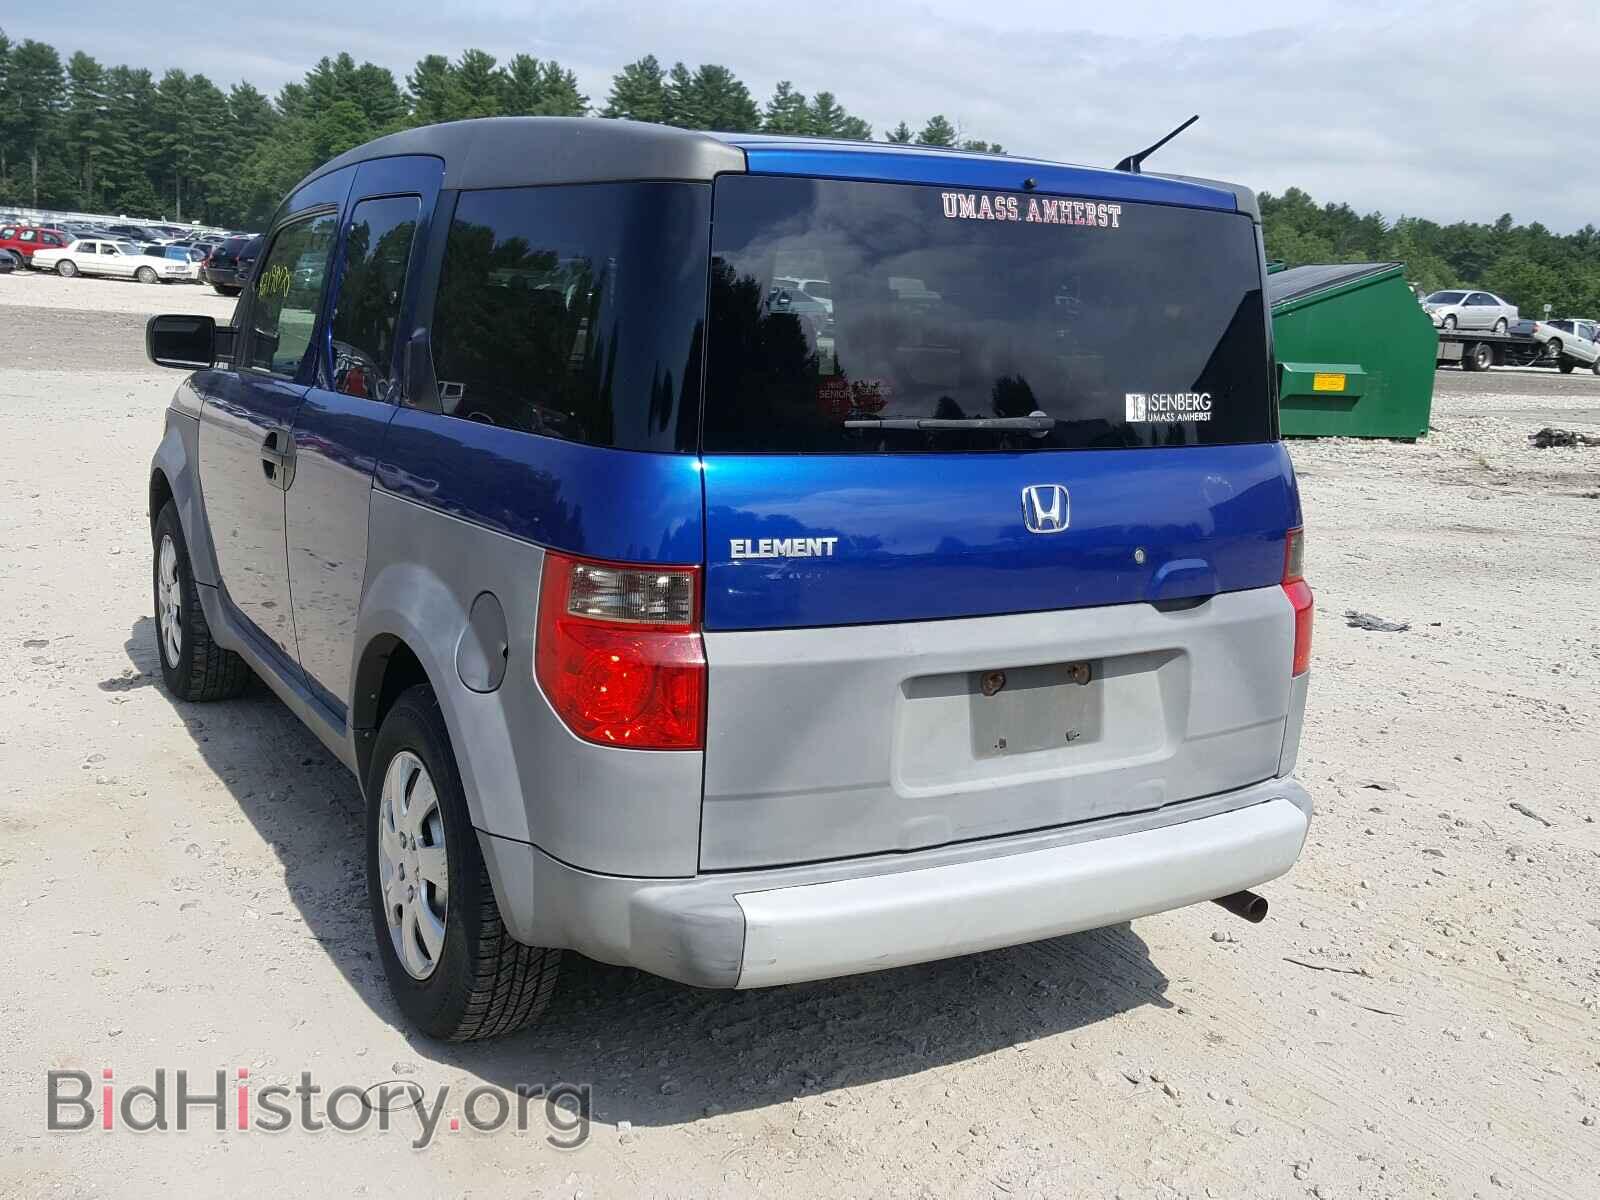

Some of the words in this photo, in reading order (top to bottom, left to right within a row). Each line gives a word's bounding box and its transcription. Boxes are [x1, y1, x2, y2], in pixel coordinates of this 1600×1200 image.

[1026, 198, 1121, 228] AMHERST
[1148, 393, 1211, 411] ISENBERG
[1147, 412, 1175, 422] UMASS
[1177, 412, 1211, 422] AMHERST
[730, 537, 838, 559] ELEMENT
